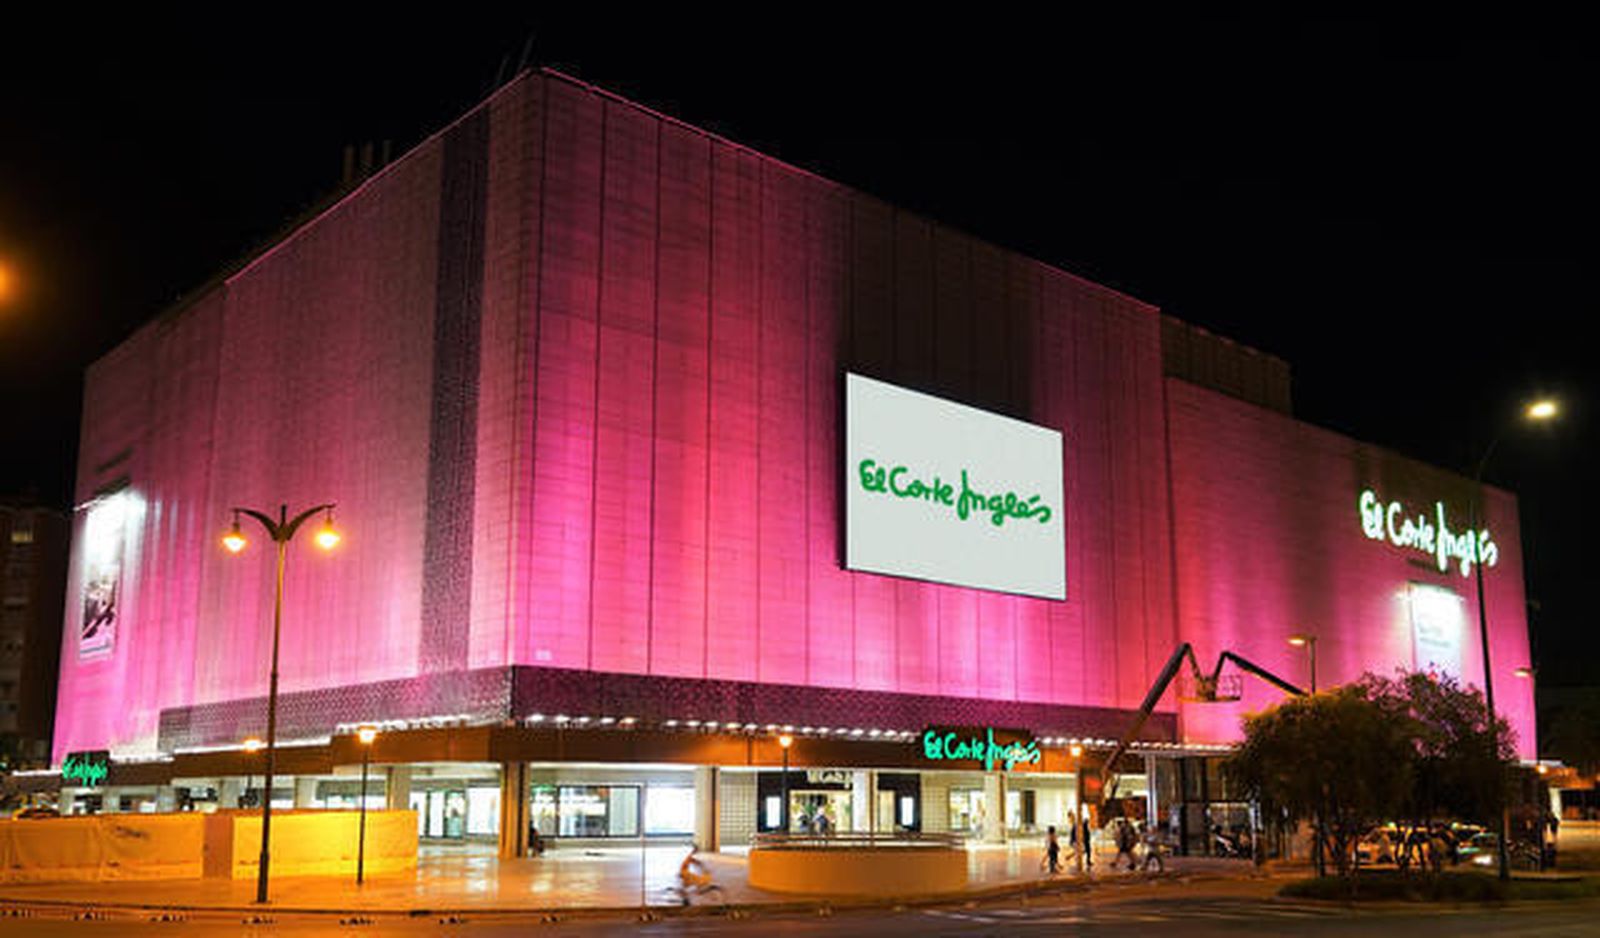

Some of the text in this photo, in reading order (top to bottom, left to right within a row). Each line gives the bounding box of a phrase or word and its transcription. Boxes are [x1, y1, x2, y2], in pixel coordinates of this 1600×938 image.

[859, 459, 1052, 526] El Corte Inglés
[1360, 490, 1385, 541] El
[1386, 501, 1435, 554] Corte
[924, 730, 943, 759] El
[944, 732, 985, 760] Corte
